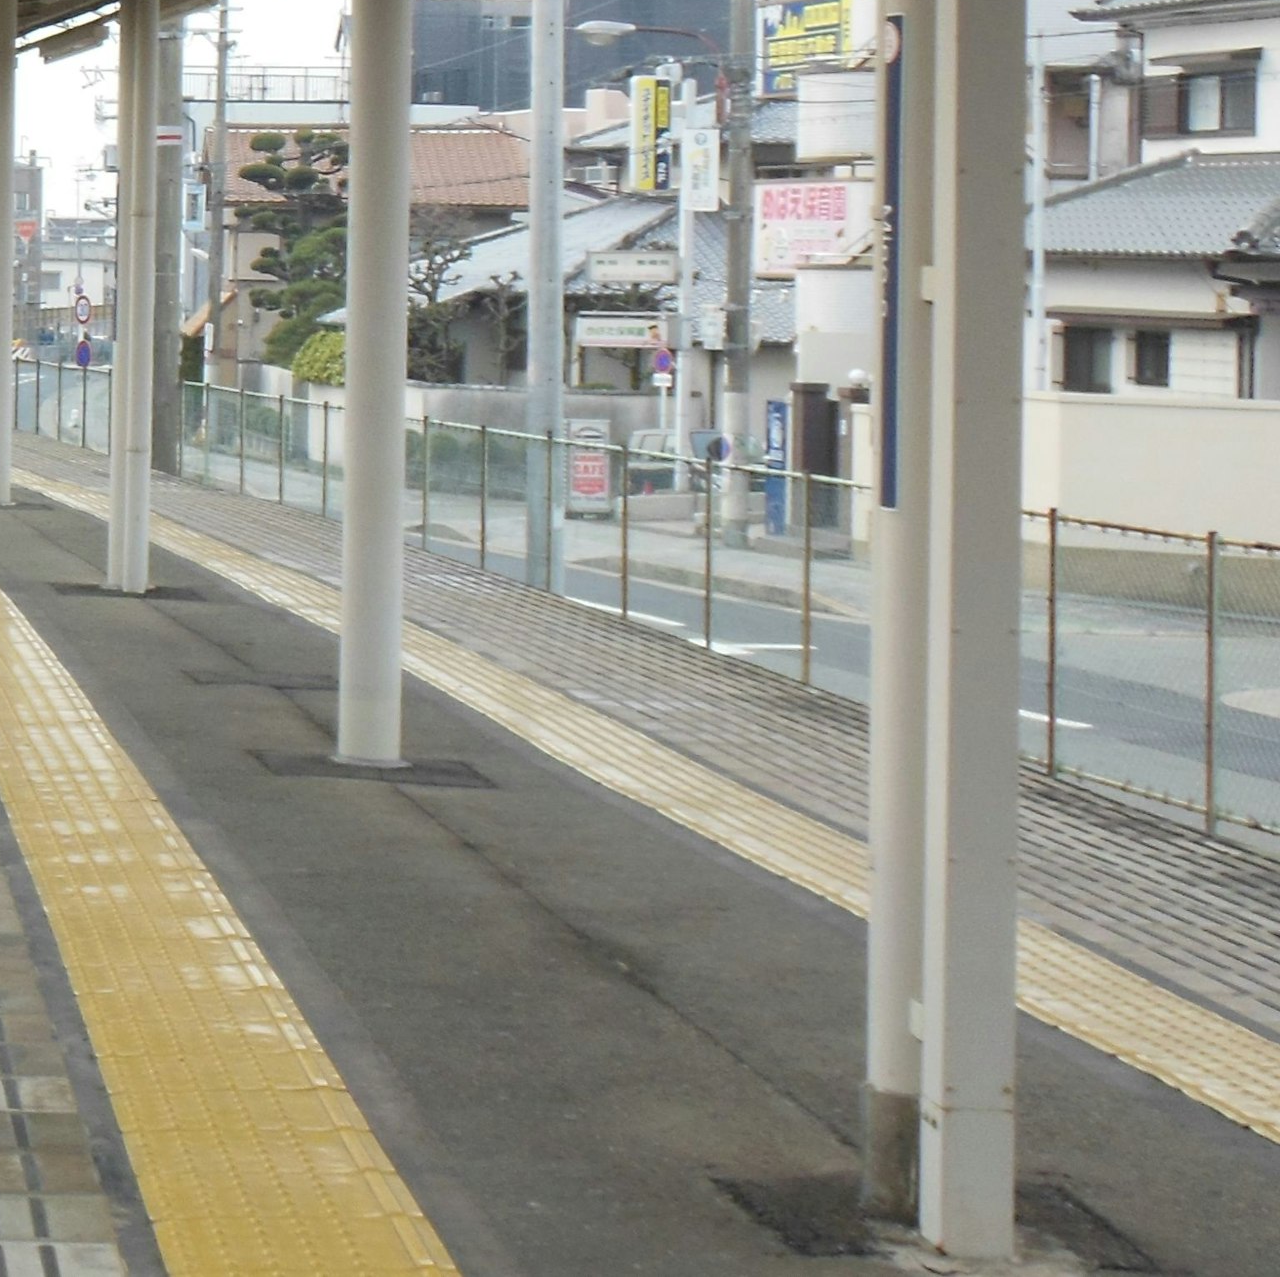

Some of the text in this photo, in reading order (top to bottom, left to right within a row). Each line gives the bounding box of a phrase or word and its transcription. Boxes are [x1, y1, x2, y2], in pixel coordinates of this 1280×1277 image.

[761, 186, 846, 220] めばえ保育園
